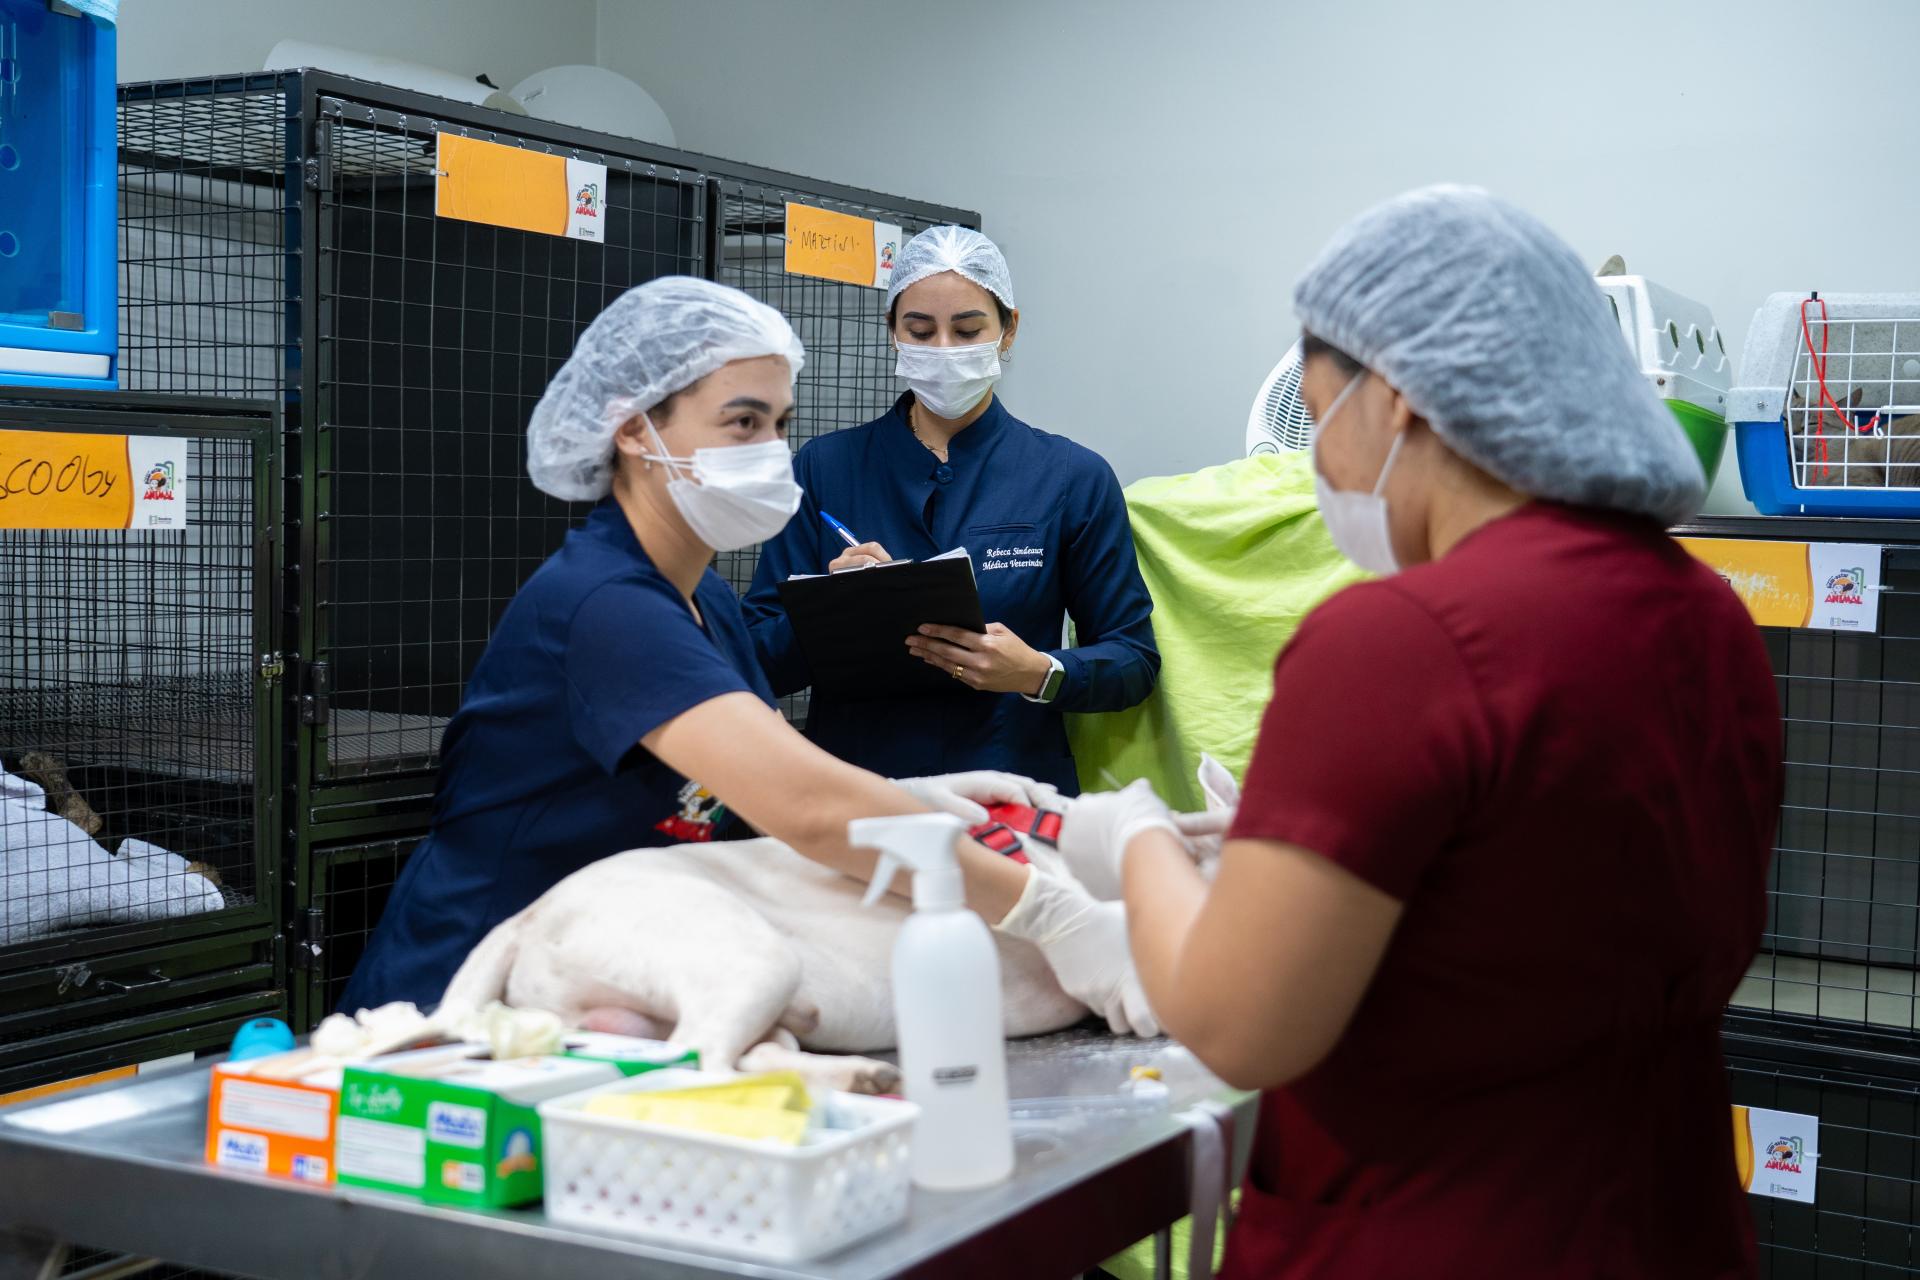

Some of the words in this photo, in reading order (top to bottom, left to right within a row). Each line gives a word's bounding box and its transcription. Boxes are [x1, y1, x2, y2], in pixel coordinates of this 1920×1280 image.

[986, 547, 1011, 558] Rebeca
[982, 559, 1009, 571] Médica
[1824, 594, 1863, 605] ANIMAL
[1764, 1160, 1802, 1174] ANIMAL
